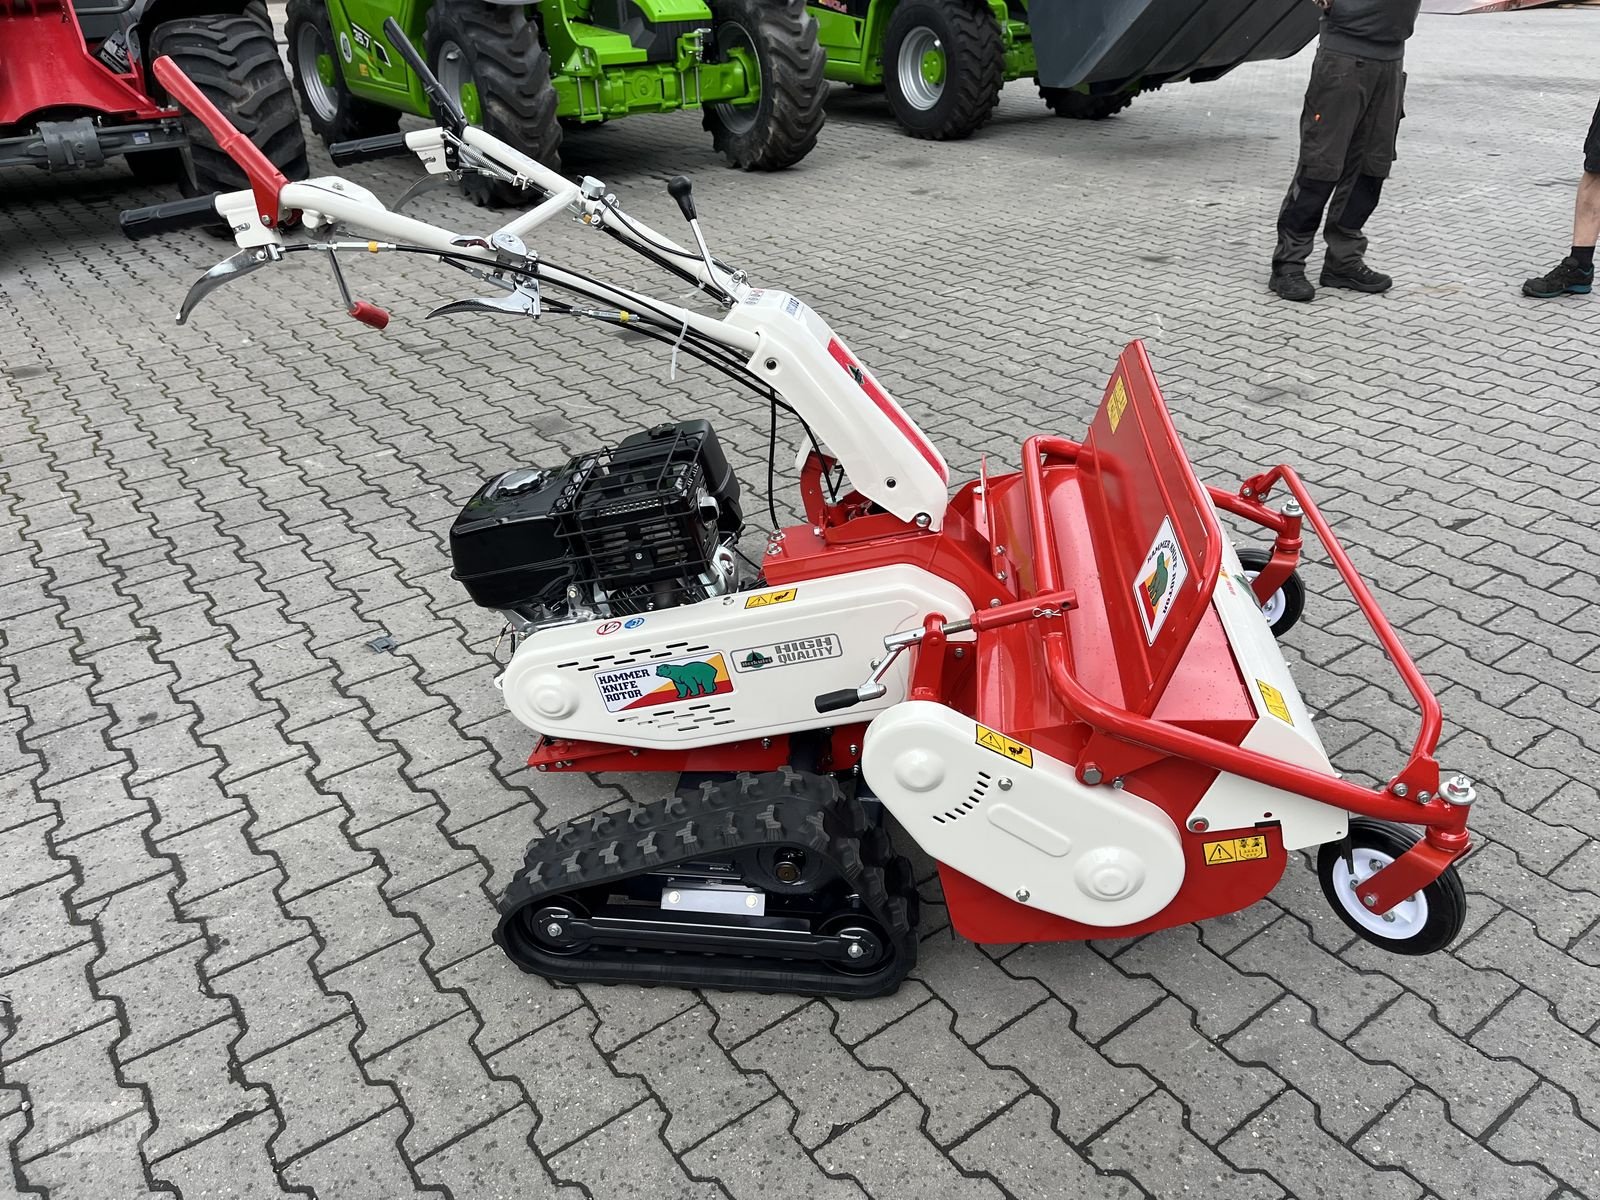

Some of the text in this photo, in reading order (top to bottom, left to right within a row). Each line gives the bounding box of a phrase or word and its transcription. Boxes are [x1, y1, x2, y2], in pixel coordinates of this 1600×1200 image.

[774, 637, 832, 654] HIGH
[777, 645, 833, 664] QUALITY
[597, 668, 651, 685] HAMMER
[601, 680, 639, 694] KNIFE
[605, 689, 643, 702] ROTOR
